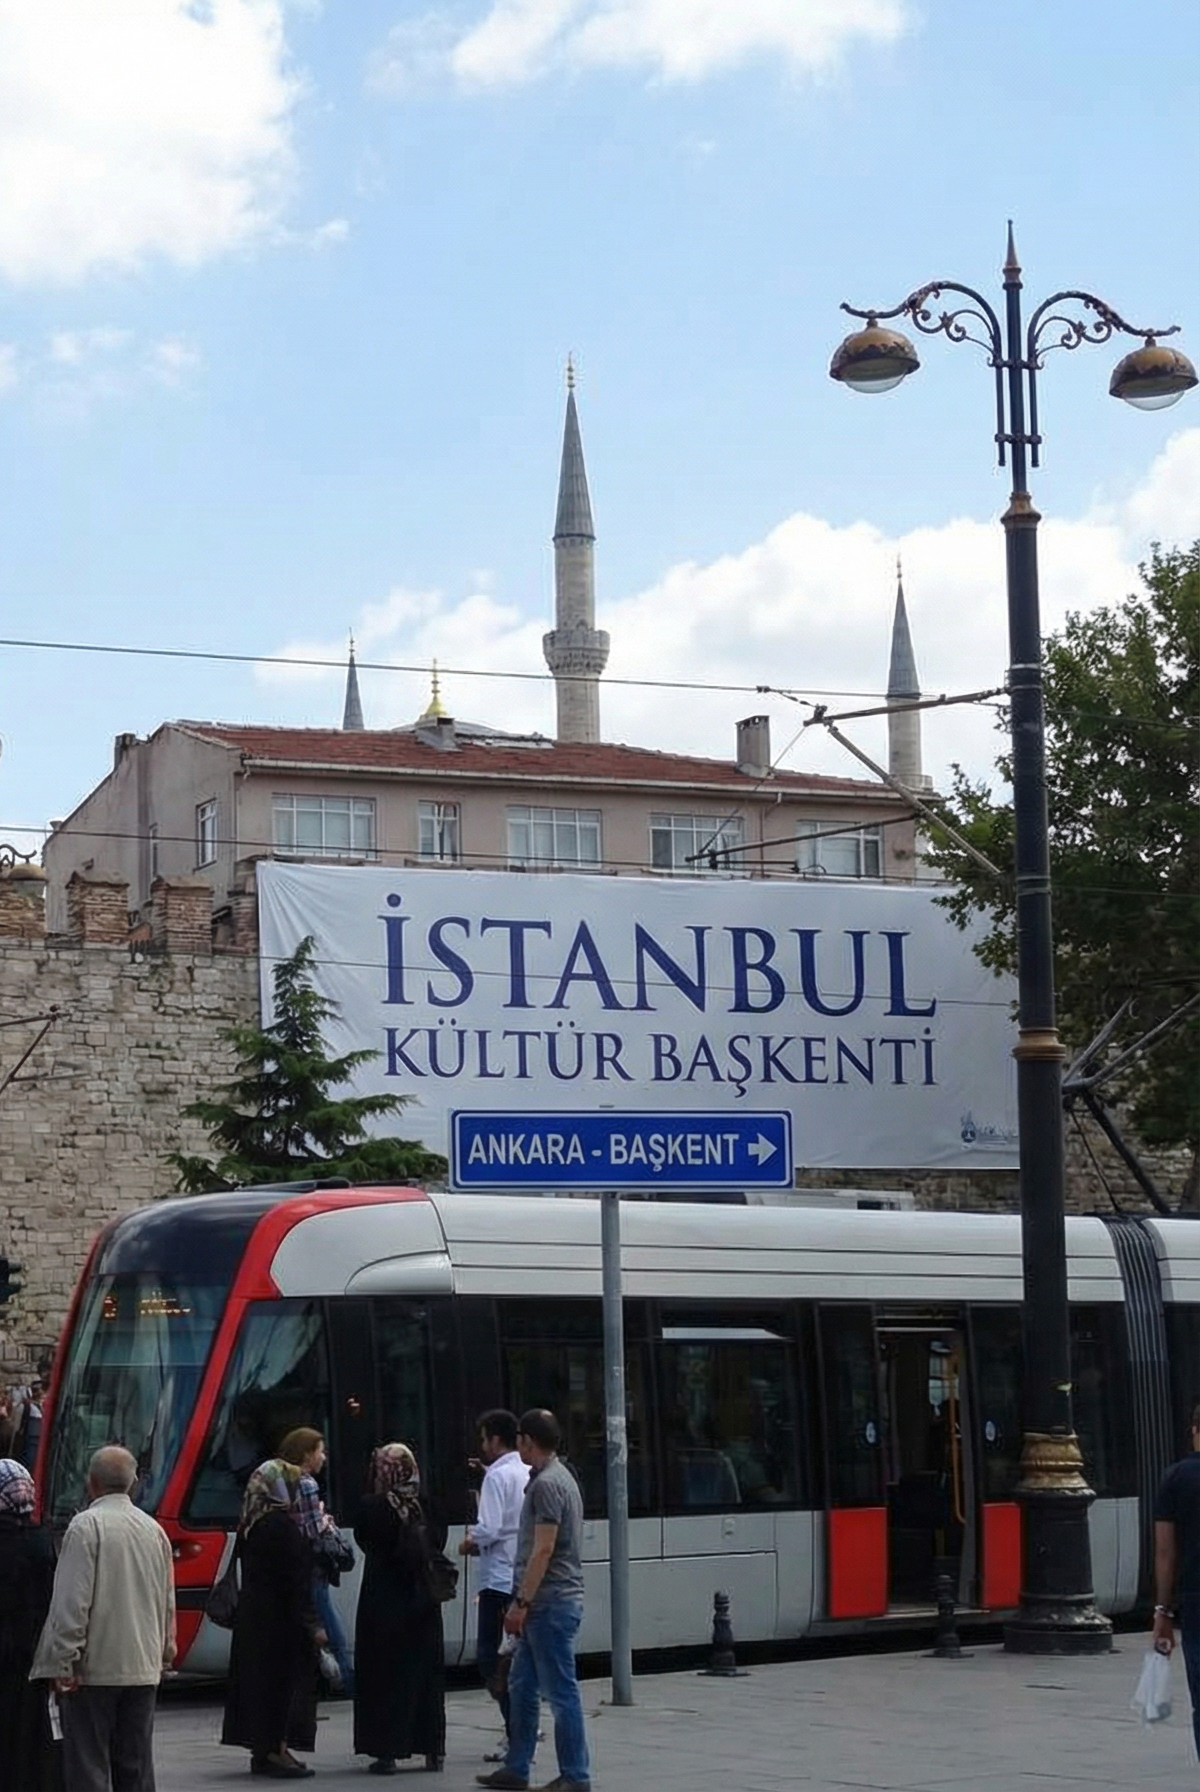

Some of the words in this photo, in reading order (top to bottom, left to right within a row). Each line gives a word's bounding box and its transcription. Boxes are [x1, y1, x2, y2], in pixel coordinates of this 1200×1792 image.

[377, 893, 937, 1018] İSTANBUL
[383, 1019, 633, 1081] KÜLTÜR
[652, 1026, 937, 1098] BAŞKENTİ
[468, 1134, 585, 1165] ANKARA
[610, 1133, 739, 1172] BAŞKENT
